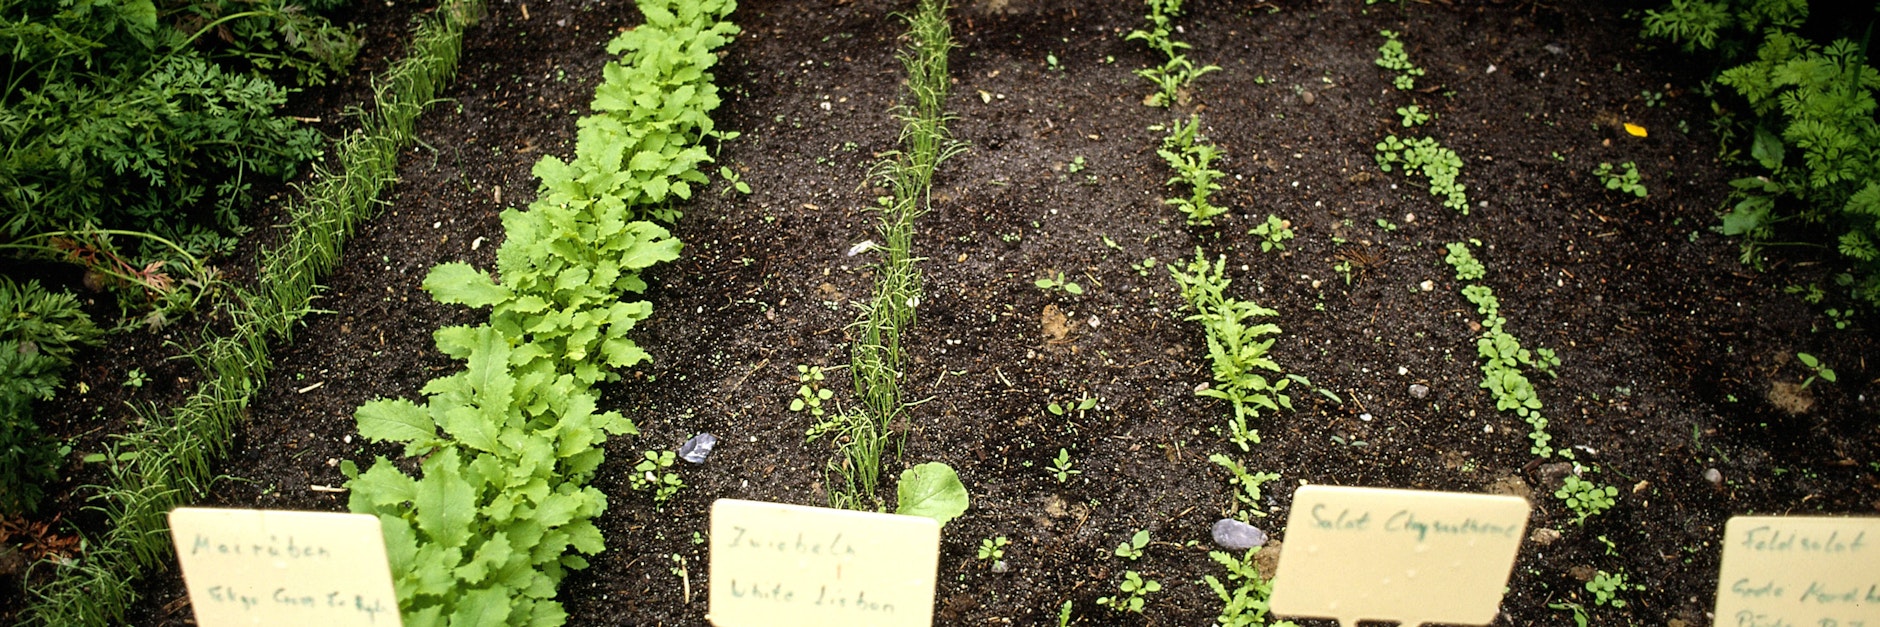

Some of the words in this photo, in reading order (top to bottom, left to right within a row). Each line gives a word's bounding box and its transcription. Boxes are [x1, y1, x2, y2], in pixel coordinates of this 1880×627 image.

[1311, 503, 1370, 529] Salat
[191, 533, 331, 559] Mairüben
[1742, 526, 1866, 552] Feldsalat
[731, 578, 794, 602] White
[813, 584, 896, 614] Lisbon
